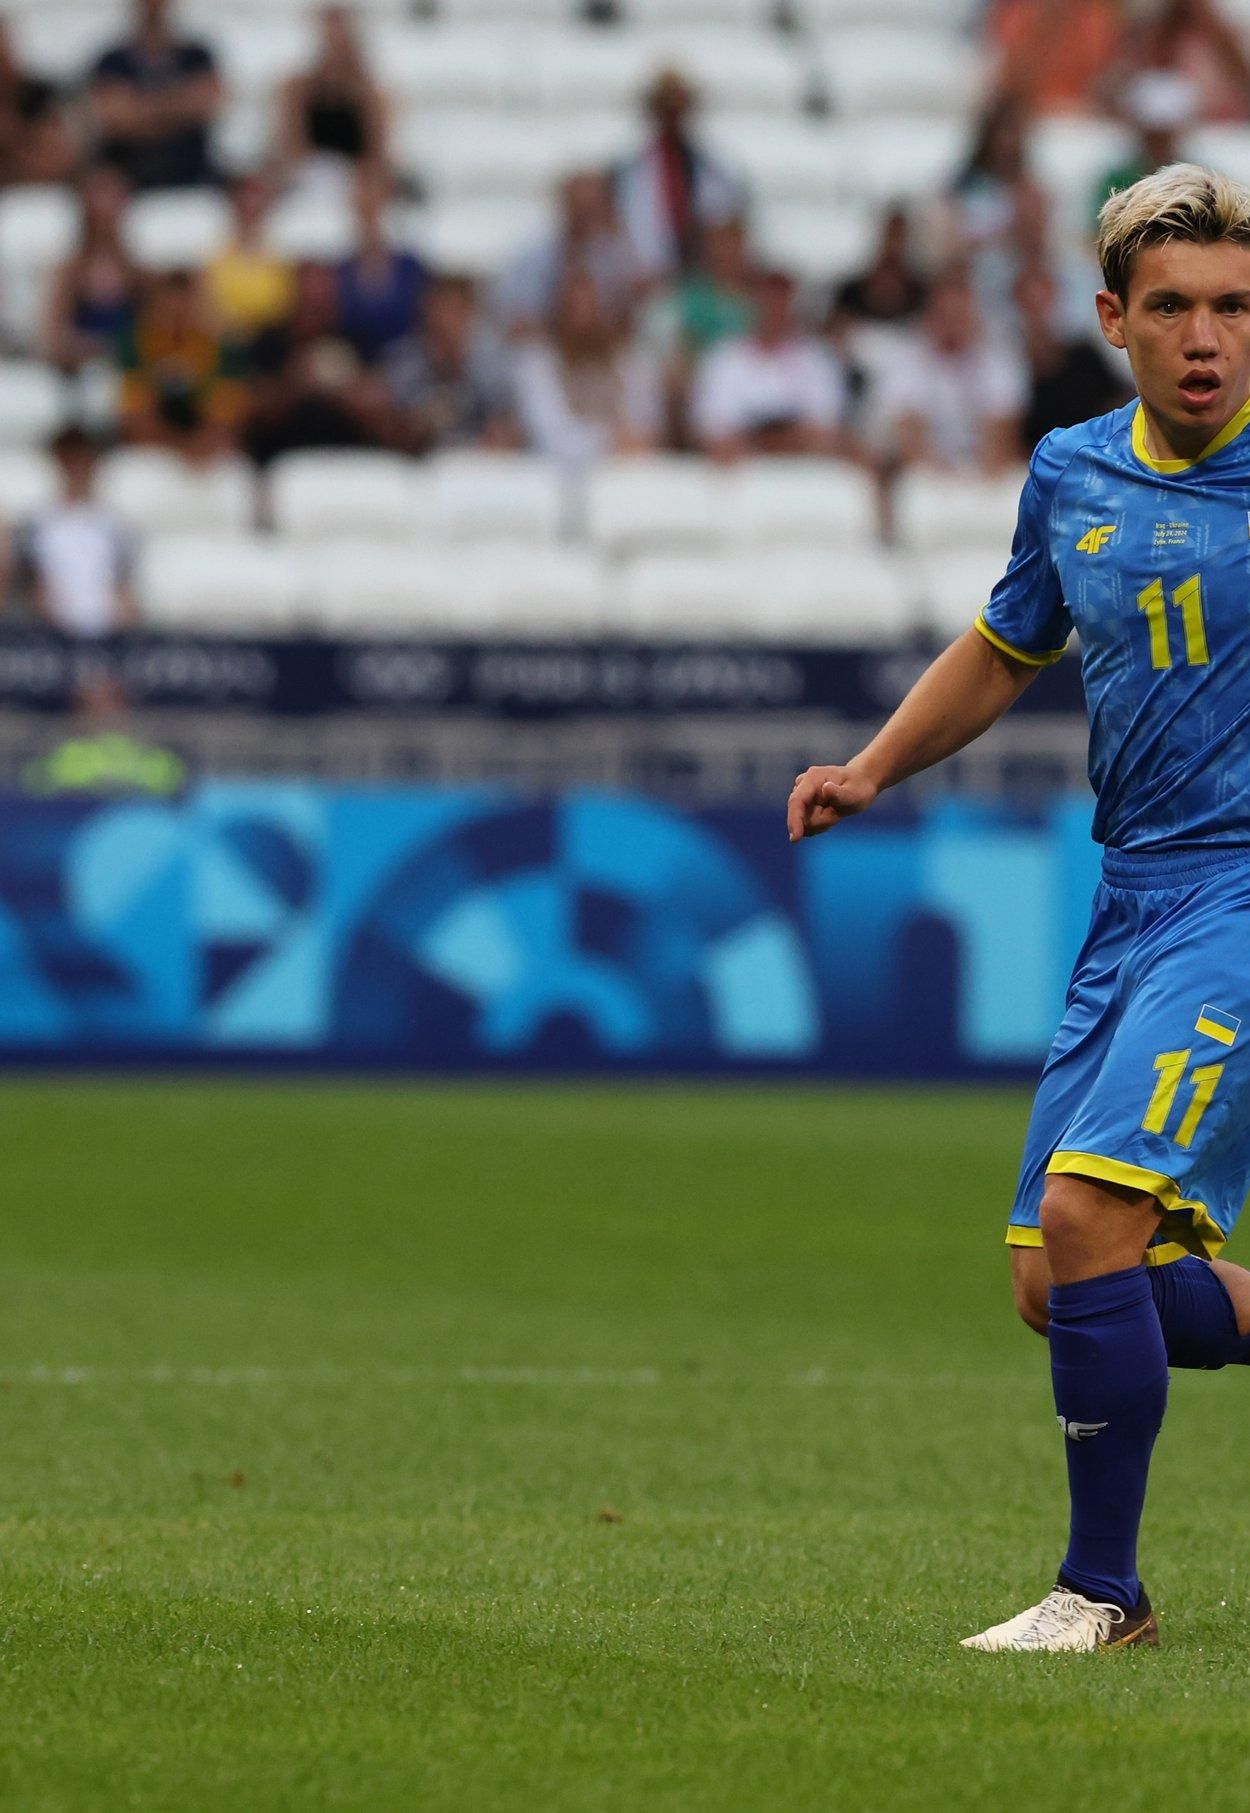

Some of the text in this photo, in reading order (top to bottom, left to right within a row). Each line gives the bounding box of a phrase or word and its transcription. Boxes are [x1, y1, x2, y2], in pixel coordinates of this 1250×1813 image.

[1076, 525, 1117, 555] 4F
[1137, 573, 1209, 669] 11
[1141, 1048, 1225, 1149] 11
